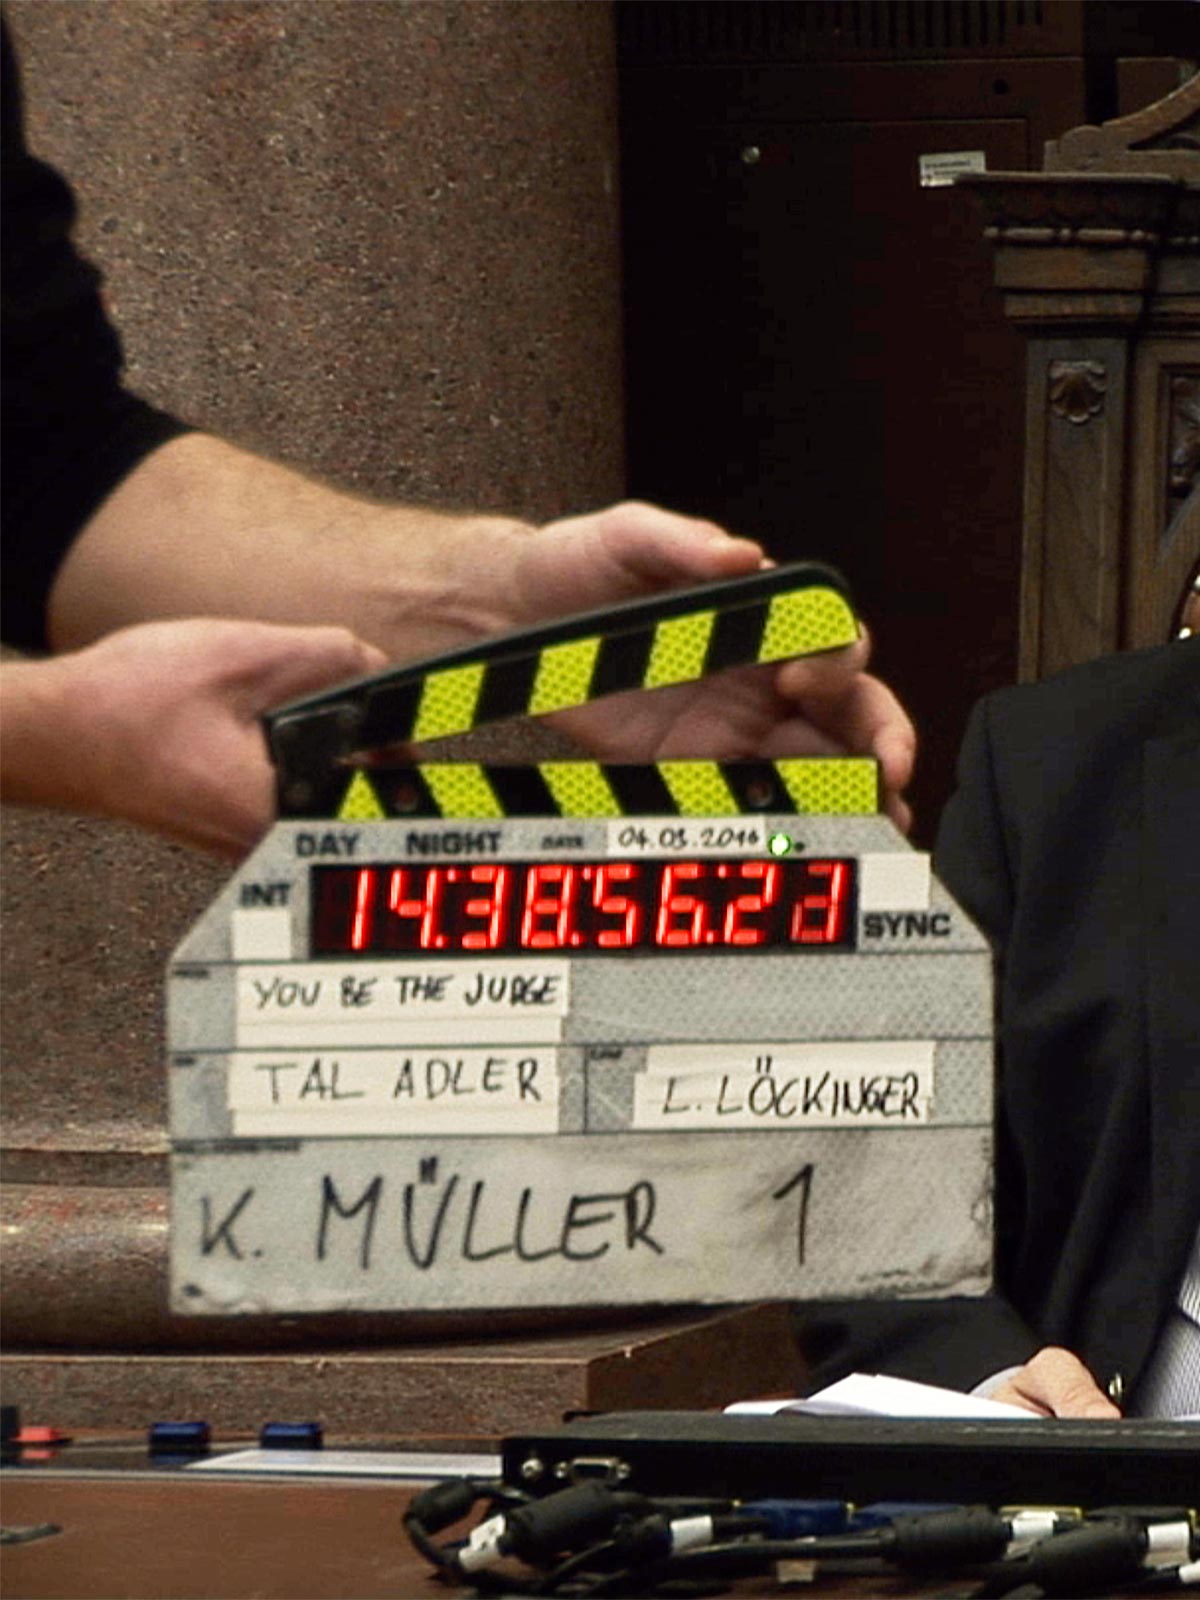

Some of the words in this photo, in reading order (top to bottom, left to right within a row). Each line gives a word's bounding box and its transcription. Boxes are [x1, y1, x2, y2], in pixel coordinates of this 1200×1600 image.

[294, 832, 361, 856] DAY
[405, 831, 502, 855] NIGHT
[240, 882, 291, 907] INT
[863, 913, 951, 938] SYNC
[252, 977, 321, 1009] YOU
[340, 975, 378, 1008] BE
[394, 974, 454, 1005] THE
[255, 1057, 364, 1104] TAL
[393, 1057, 541, 1102] ADLER
[200, 1187, 262, 1261] K.
[314, 1156, 665, 1271] MÜLLER
[773, 1163, 815, 1266] 1
